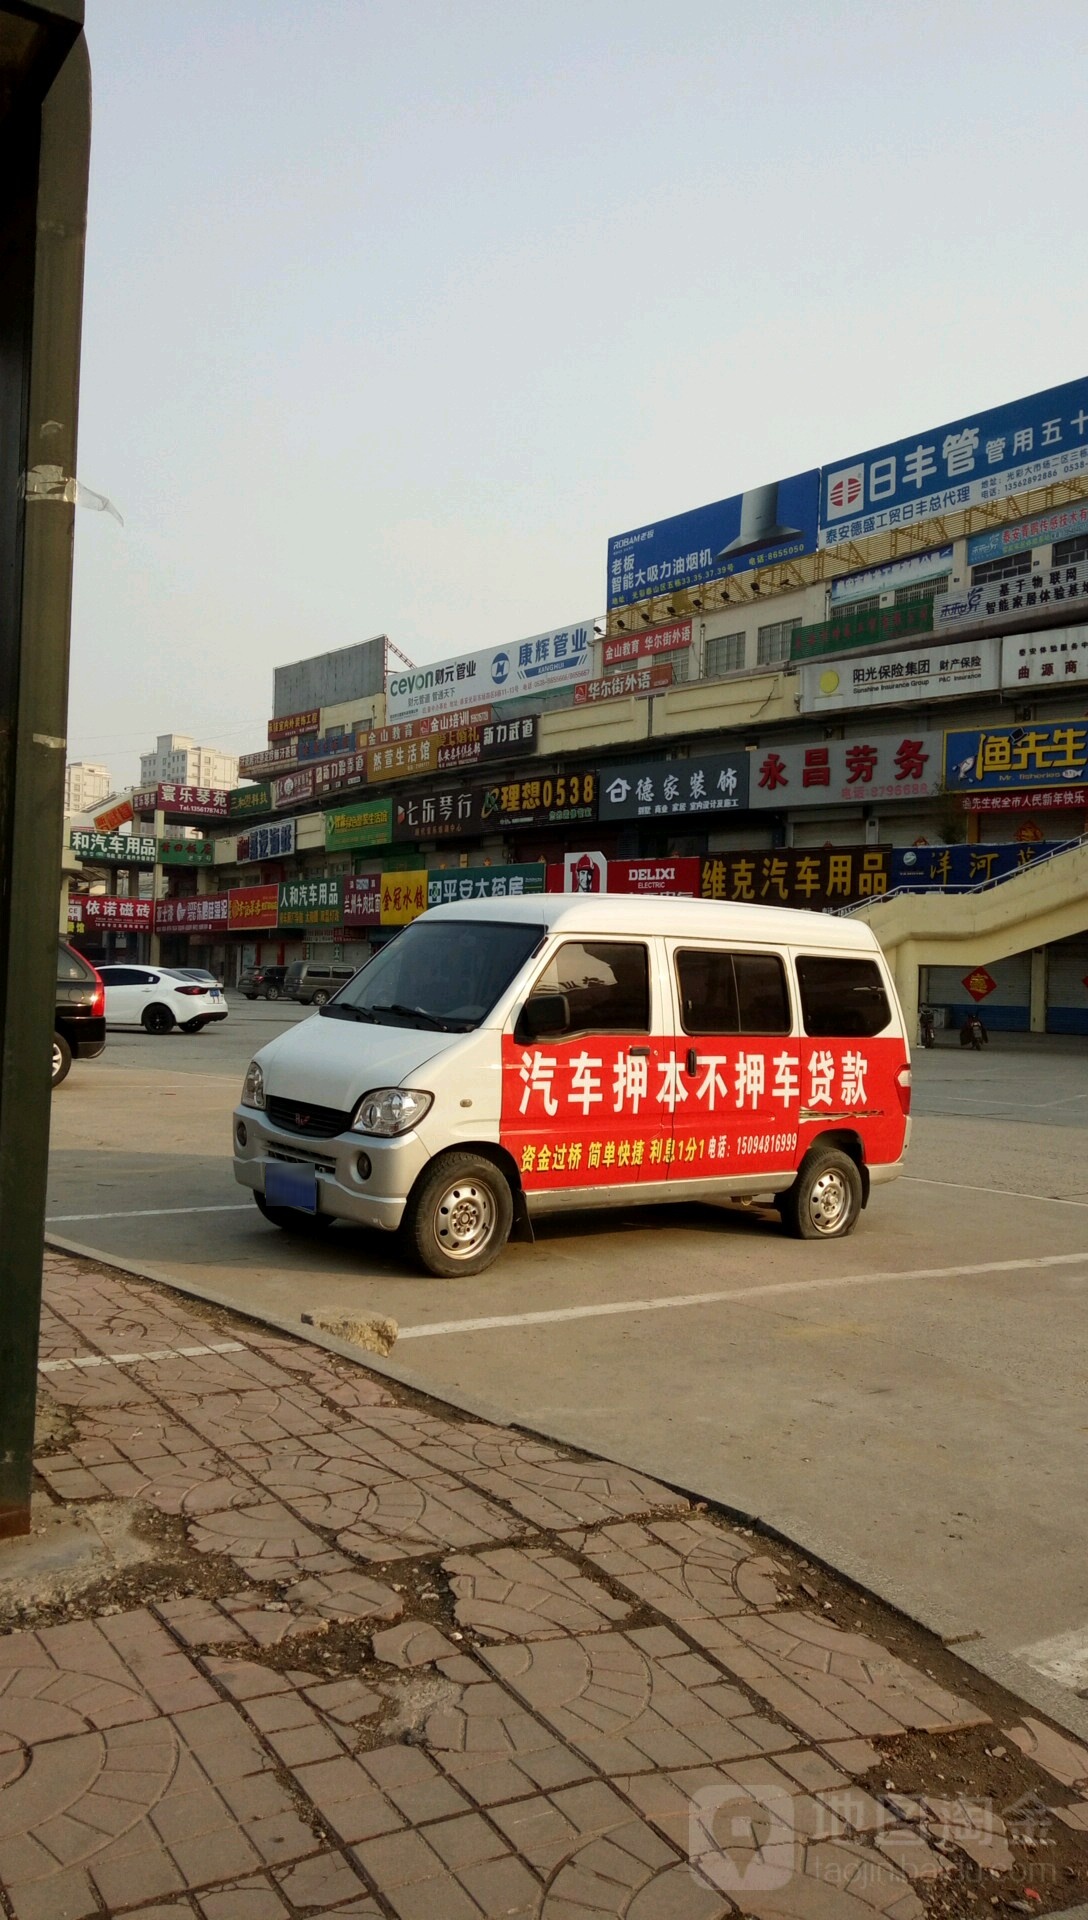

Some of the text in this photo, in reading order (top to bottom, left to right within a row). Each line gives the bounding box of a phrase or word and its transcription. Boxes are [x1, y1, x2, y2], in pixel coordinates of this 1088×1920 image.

[985, 409, 1088, 464] 管用五十
[869, 427, 980, 503] 日丰管
[825, 485, 970, 544] 泰安德盛工贸日丰总代理
[611, 553, 635, 575] 老板
[611, 547, 713, 594] 智能大吸力油烟机
[999, 567, 1077, 597] 基于物联网
[518, 627, 587, 667] 康辉管业
[605, 625, 691, 660] 金山教育 华尔街外语
[434, 660, 477, 685] 财元管业
[853, 656, 982, 683] 阳光保险集团 财产保险
[588, 671, 651, 700] 华尔街外语
[853, 685, 879, 694] Sunshine
[881, 682, 909, 692] Insurance
[910, 678, 930, 689] Group
[368, 723, 413, 746] 金山教育
[430, 711, 470, 733] 金山培训
[483, 719, 533, 746] 新力武道
[758, 739, 929, 790] 永昌劳务
[501, 774, 594, 812] 理想0538
[635, 767, 739, 802] 德家装饰
[72, 832, 156, 857] 和汽车用品
[443, 876, 524, 900] 平安大药房
[628, 867, 676, 881] DELIXI
[637, 881, 665, 889] ELECTRIC
[702, 851, 887, 900] 维克汽车用品
[280, 882, 339, 907] 人和汽车用品
[382, 887, 425, 911] 金冠水饺
[519, 1050, 868, 1116] 汽车押本不押车贷款
[521, 1142, 582, 1173] 资金过桥
[588, 1138, 645, 1168] 简单快捷
[649, 1137, 705, 1164] 利息1分1
[736, 1132, 798, 1153] 15094816999
